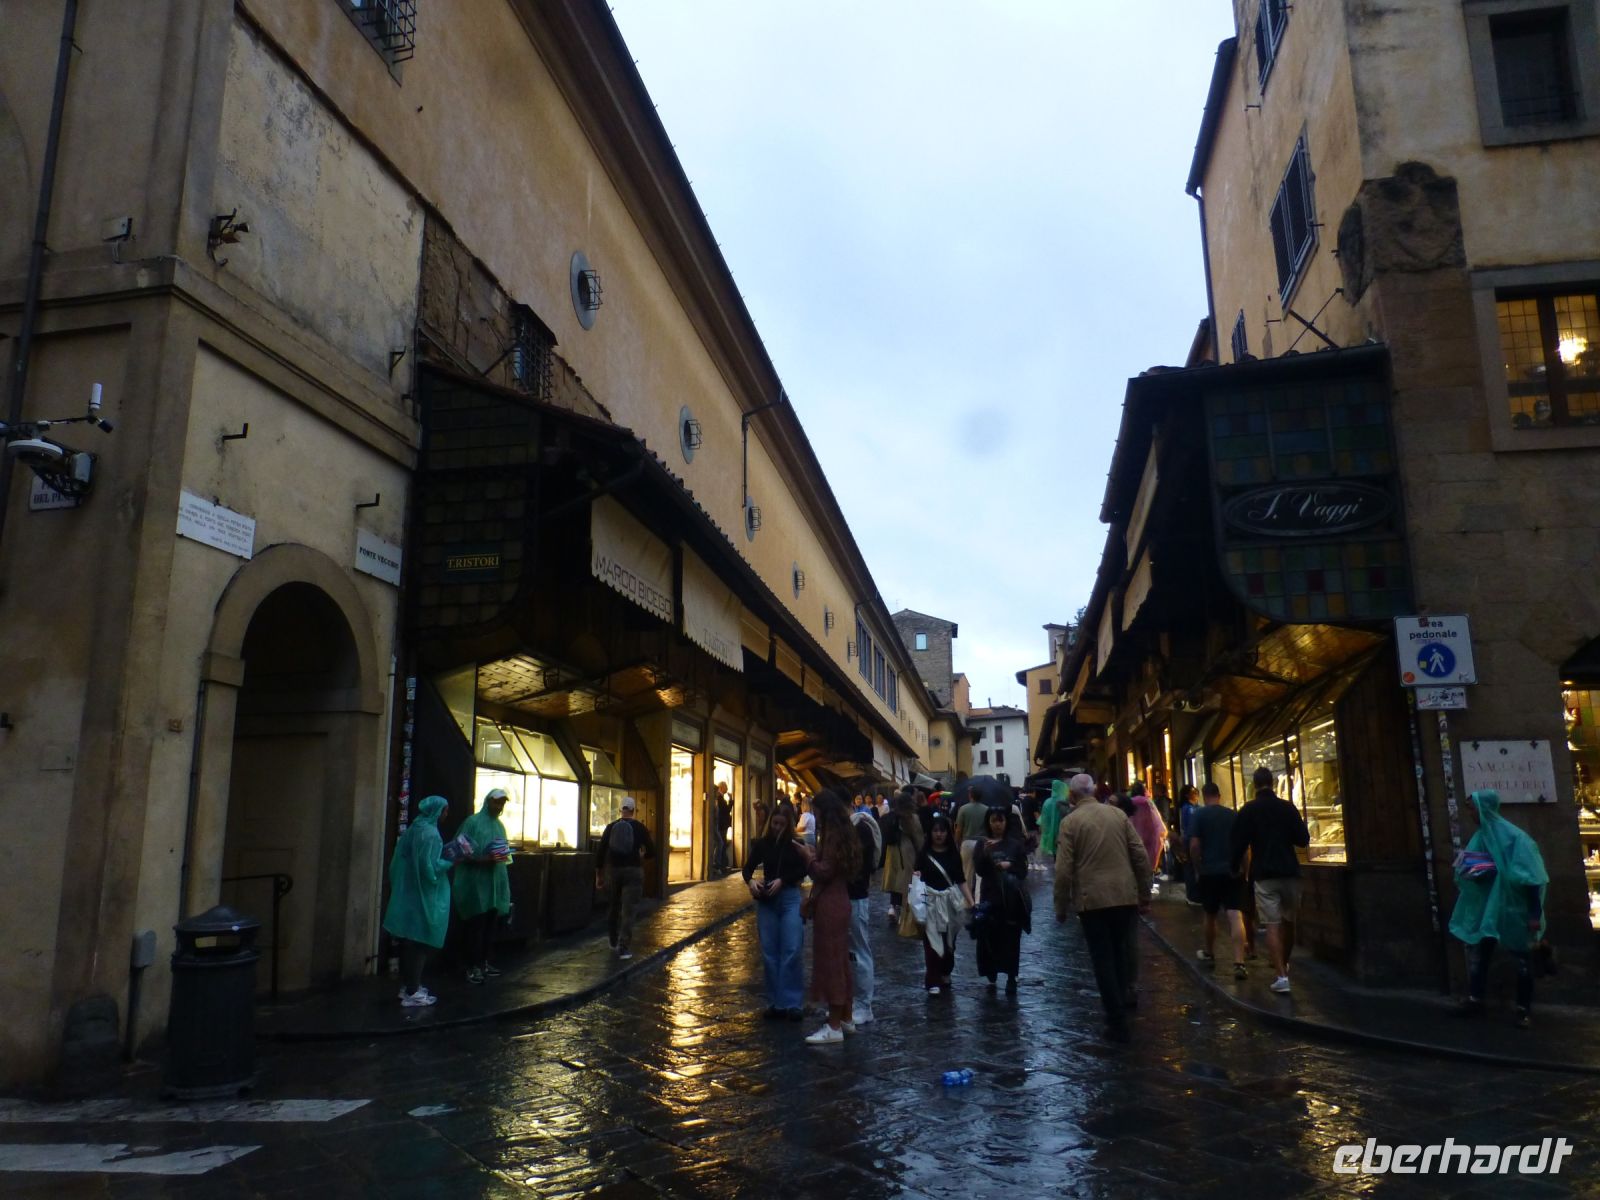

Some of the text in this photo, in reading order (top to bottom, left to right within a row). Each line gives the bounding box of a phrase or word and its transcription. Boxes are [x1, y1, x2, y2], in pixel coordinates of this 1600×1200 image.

[1289, 490, 1365, 523] Vaggi
[359, 546, 377, 560] PONTE
[595, 552, 672, 616] MARCO BICEGO
[1419, 617, 1444, 628] rea
[1409, 629, 1458, 641] pedonale
